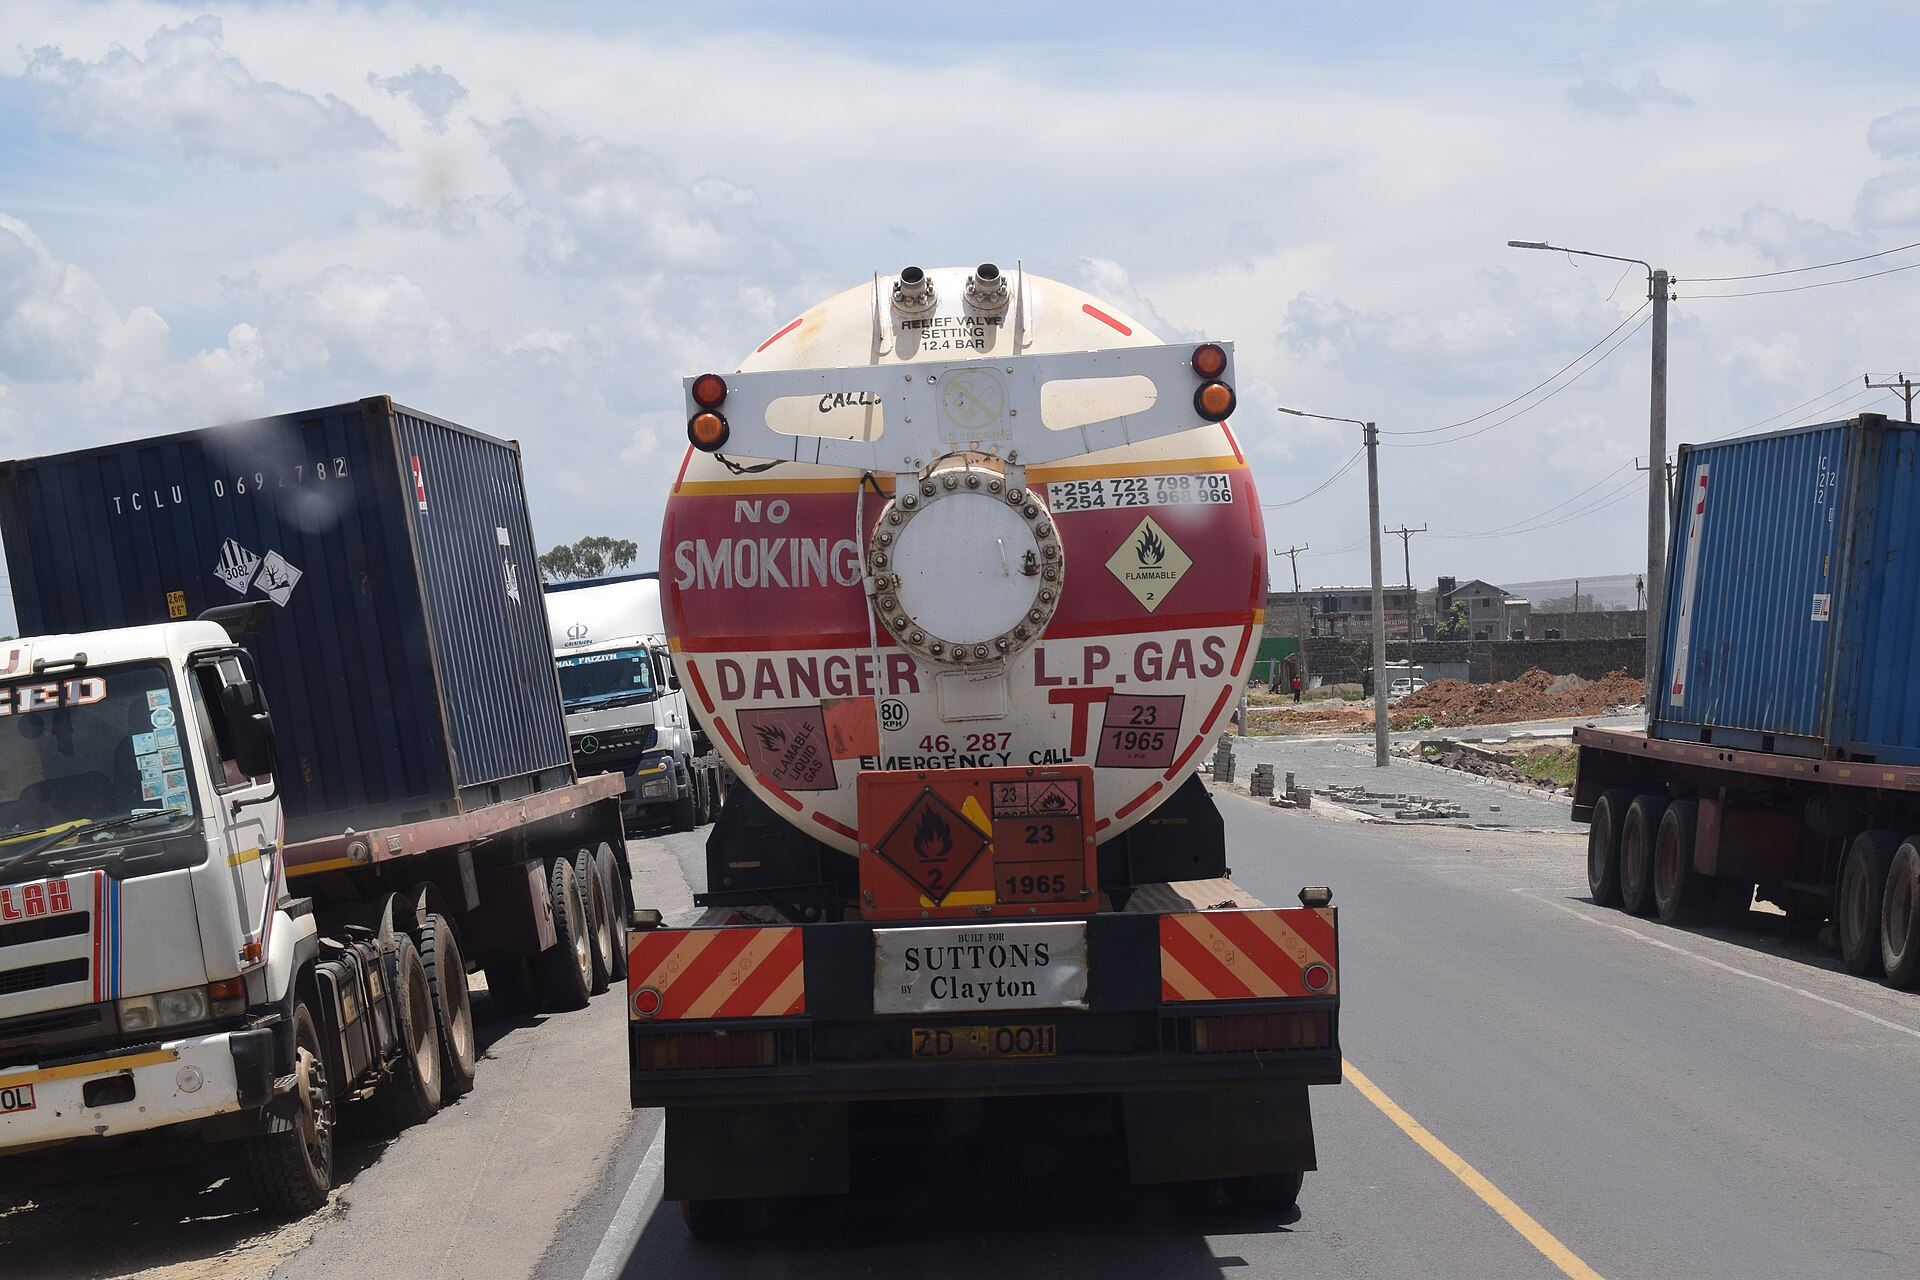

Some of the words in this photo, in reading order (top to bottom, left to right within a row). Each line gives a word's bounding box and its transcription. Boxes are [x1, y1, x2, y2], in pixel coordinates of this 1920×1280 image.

[901, 317, 952, 330] RELIEF
[956, 316, 1002, 326] VALVE
[921, 328, 985, 339] SETTING
[922, 340, 950, 351] 12.4
[955, 340, 985, 349] BAR
[1051, 480, 1104, 496] +254
[1110, 478, 1148, 492] 722
[1154, 477, 1191, 490] 798
[1196, 476, 1229, 489] 701
[113, 485, 182, 514] TCLU
[1053, 494, 1106, 510] +254
[1112, 492, 1150, 506] 723
[1198, 489, 1232, 502] 966
[734, 499, 791, 524] NO
[225, 564, 249, 581] 3082
[674, 538, 862, 591] SMOKING
[1125, 571, 1176, 581] FLAMMABLE
[1146, 592, 1154, 600] 2
[564, 639, 593, 647] CROWN
[715, 653, 920, 701] DANGER
[0, 676, 107, 717] ED
[881, 703, 904, 720] 80
[1129, 704, 1157, 725] 23
[882, 720, 902, 728] KPH
[772, 721, 815, 780] FLAMABLE
[965, 732, 1012, 752] 287
[1112, 731, 1164, 751] 1965
[789, 745, 816, 781] LIQUID
[859, 752, 1012, 771] EMERGENCY
[1028, 748, 1073, 766] CALL
[803, 759, 823, 783] GAS
[1001, 787, 1017, 803] 23
[1025, 824, 1055, 845] 23
[927, 868, 944, 891] 2
[1005, 874, 1066, 895] 1965
[958, 933, 983, 943] BUILT
[988, 932, 1005, 942] FOR
[904, 942, 1050, 972] SUTTONS
[901, 985, 913, 995] BY
[930, 975, 1037, 1003] Clayton
[914, 1029, 954, 1057] ZD
